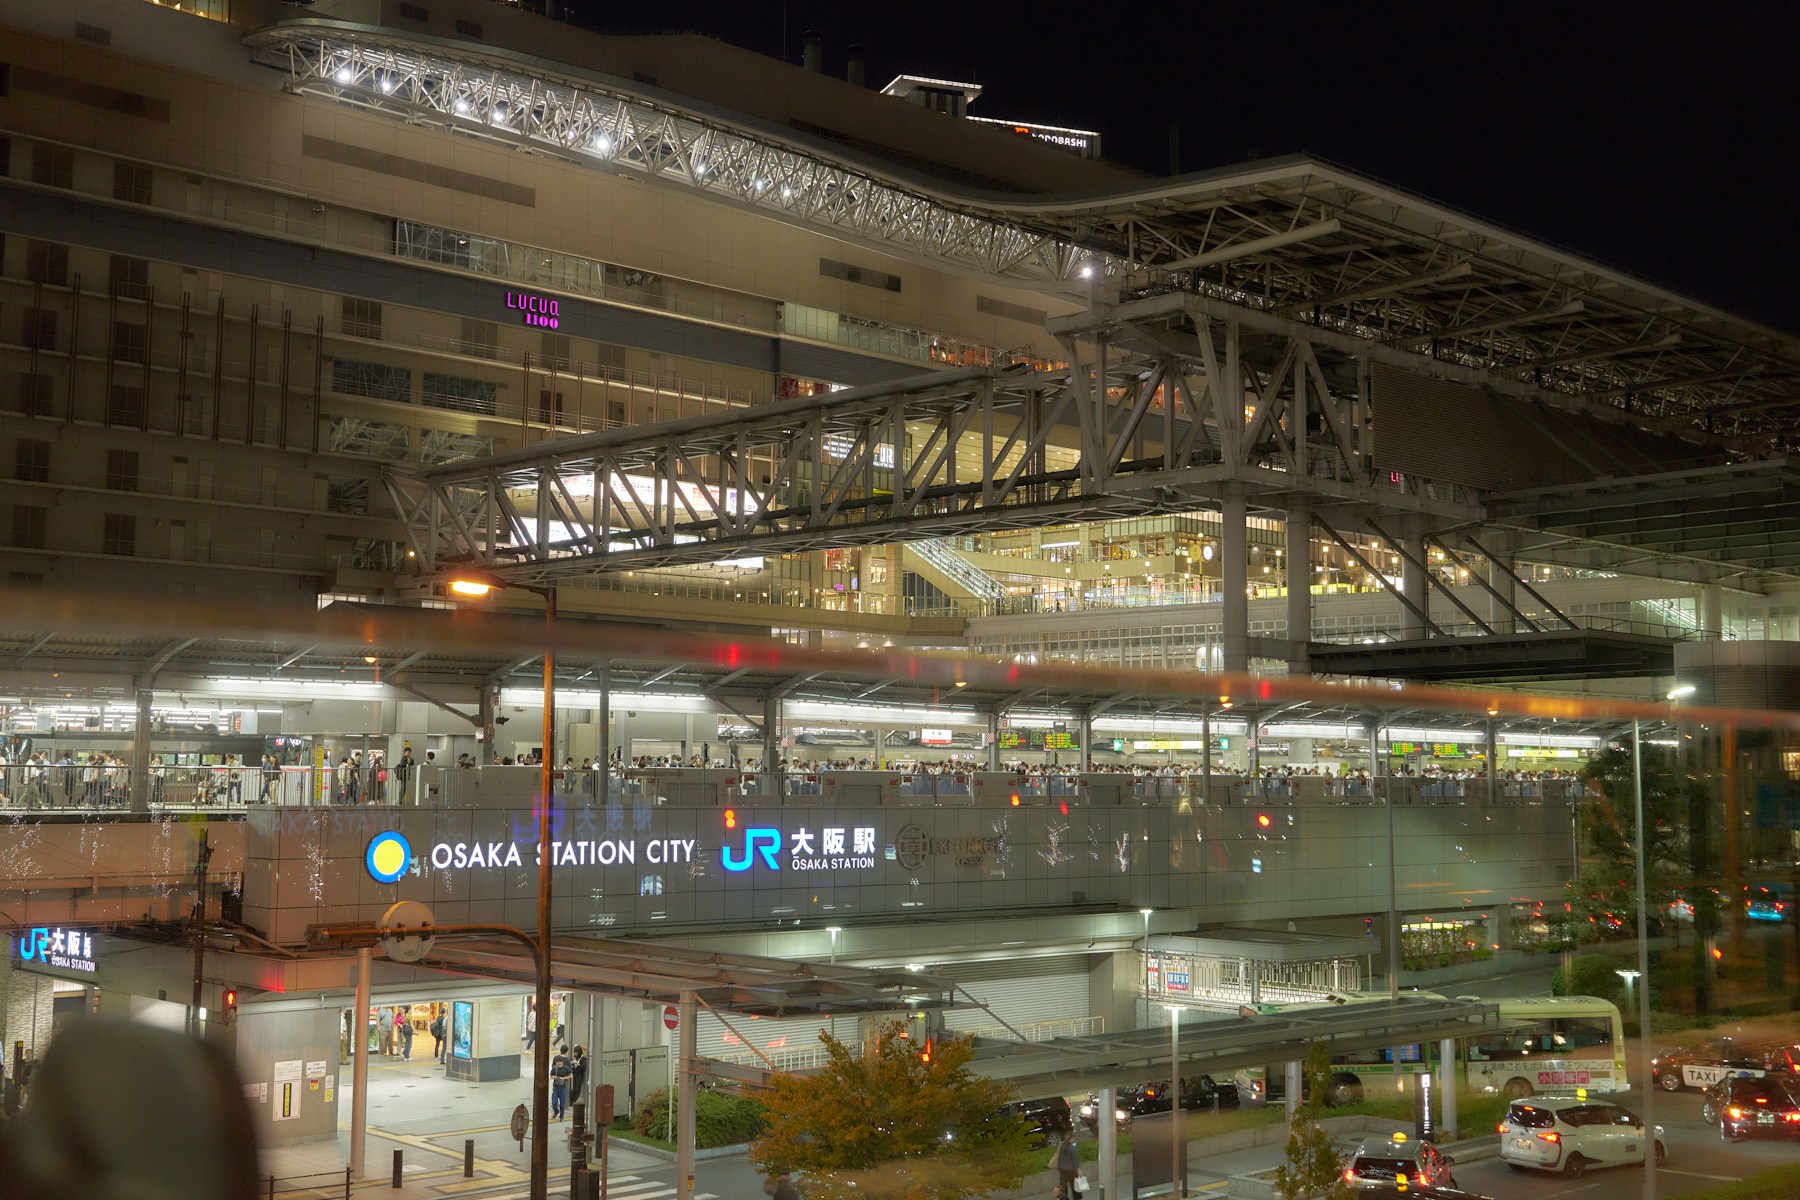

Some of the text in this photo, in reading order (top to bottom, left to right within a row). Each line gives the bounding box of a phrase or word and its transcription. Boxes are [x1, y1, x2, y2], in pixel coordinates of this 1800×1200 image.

[1031, 133, 1087, 148] DOBASHI
[526, 313, 559, 329] 1100
[431, 841, 522, 869] OSAKA
[646, 838, 695, 863] CITY
[722, 827, 875, 871] JR 大阪駅
[831, 857, 875, 869] STATION
[20, 928, 48, 963] JR
[71, 959, 96, 972] STATION
[1538, 1072, 1590, 1084] 小児専門
[1688, 1070, 1717, 1083] TAXI
